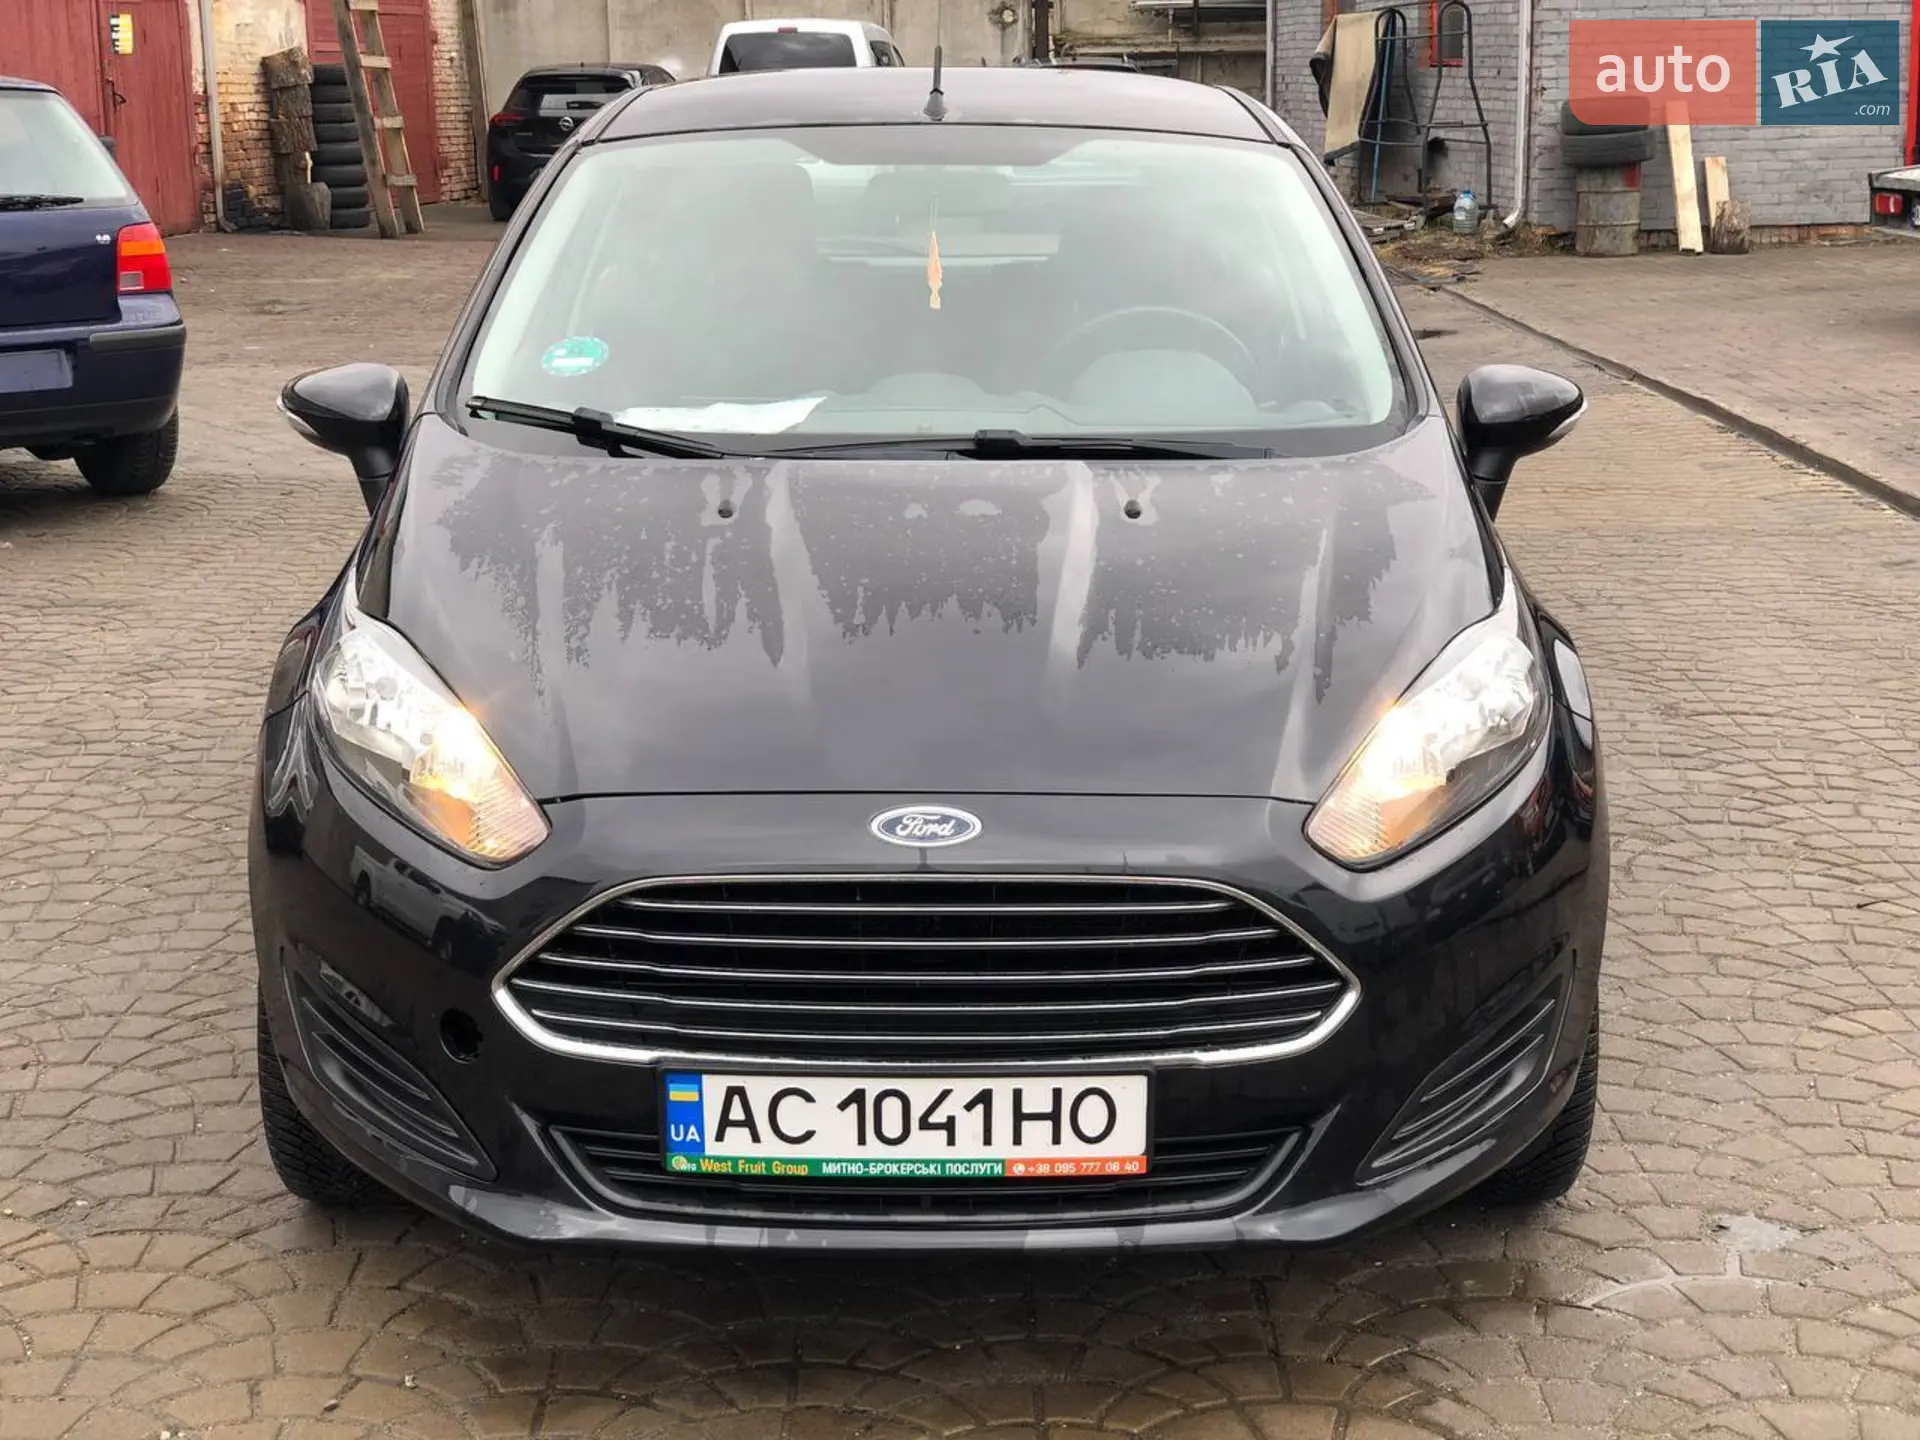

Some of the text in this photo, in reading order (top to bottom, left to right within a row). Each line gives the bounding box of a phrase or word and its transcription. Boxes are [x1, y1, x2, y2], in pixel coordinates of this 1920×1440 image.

[895, 813, 956, 837] Ford
[714, 1085, 1117, 1147] AC 1041 HO
[670, 1124, 701, 1142] UA
[700, 1159, 732, 1173] West
[738, 1160, 766, 1174] Fruit
[772, 1160, 809, 1175] Group
[822, 1162, 1003, 1175] МИТНО-БРОКЕРСЬКІ ПОСЛУГИ
[1027, 1162, 1050, 1174] +38
[1080, 1161, 1101, 1173] 777
